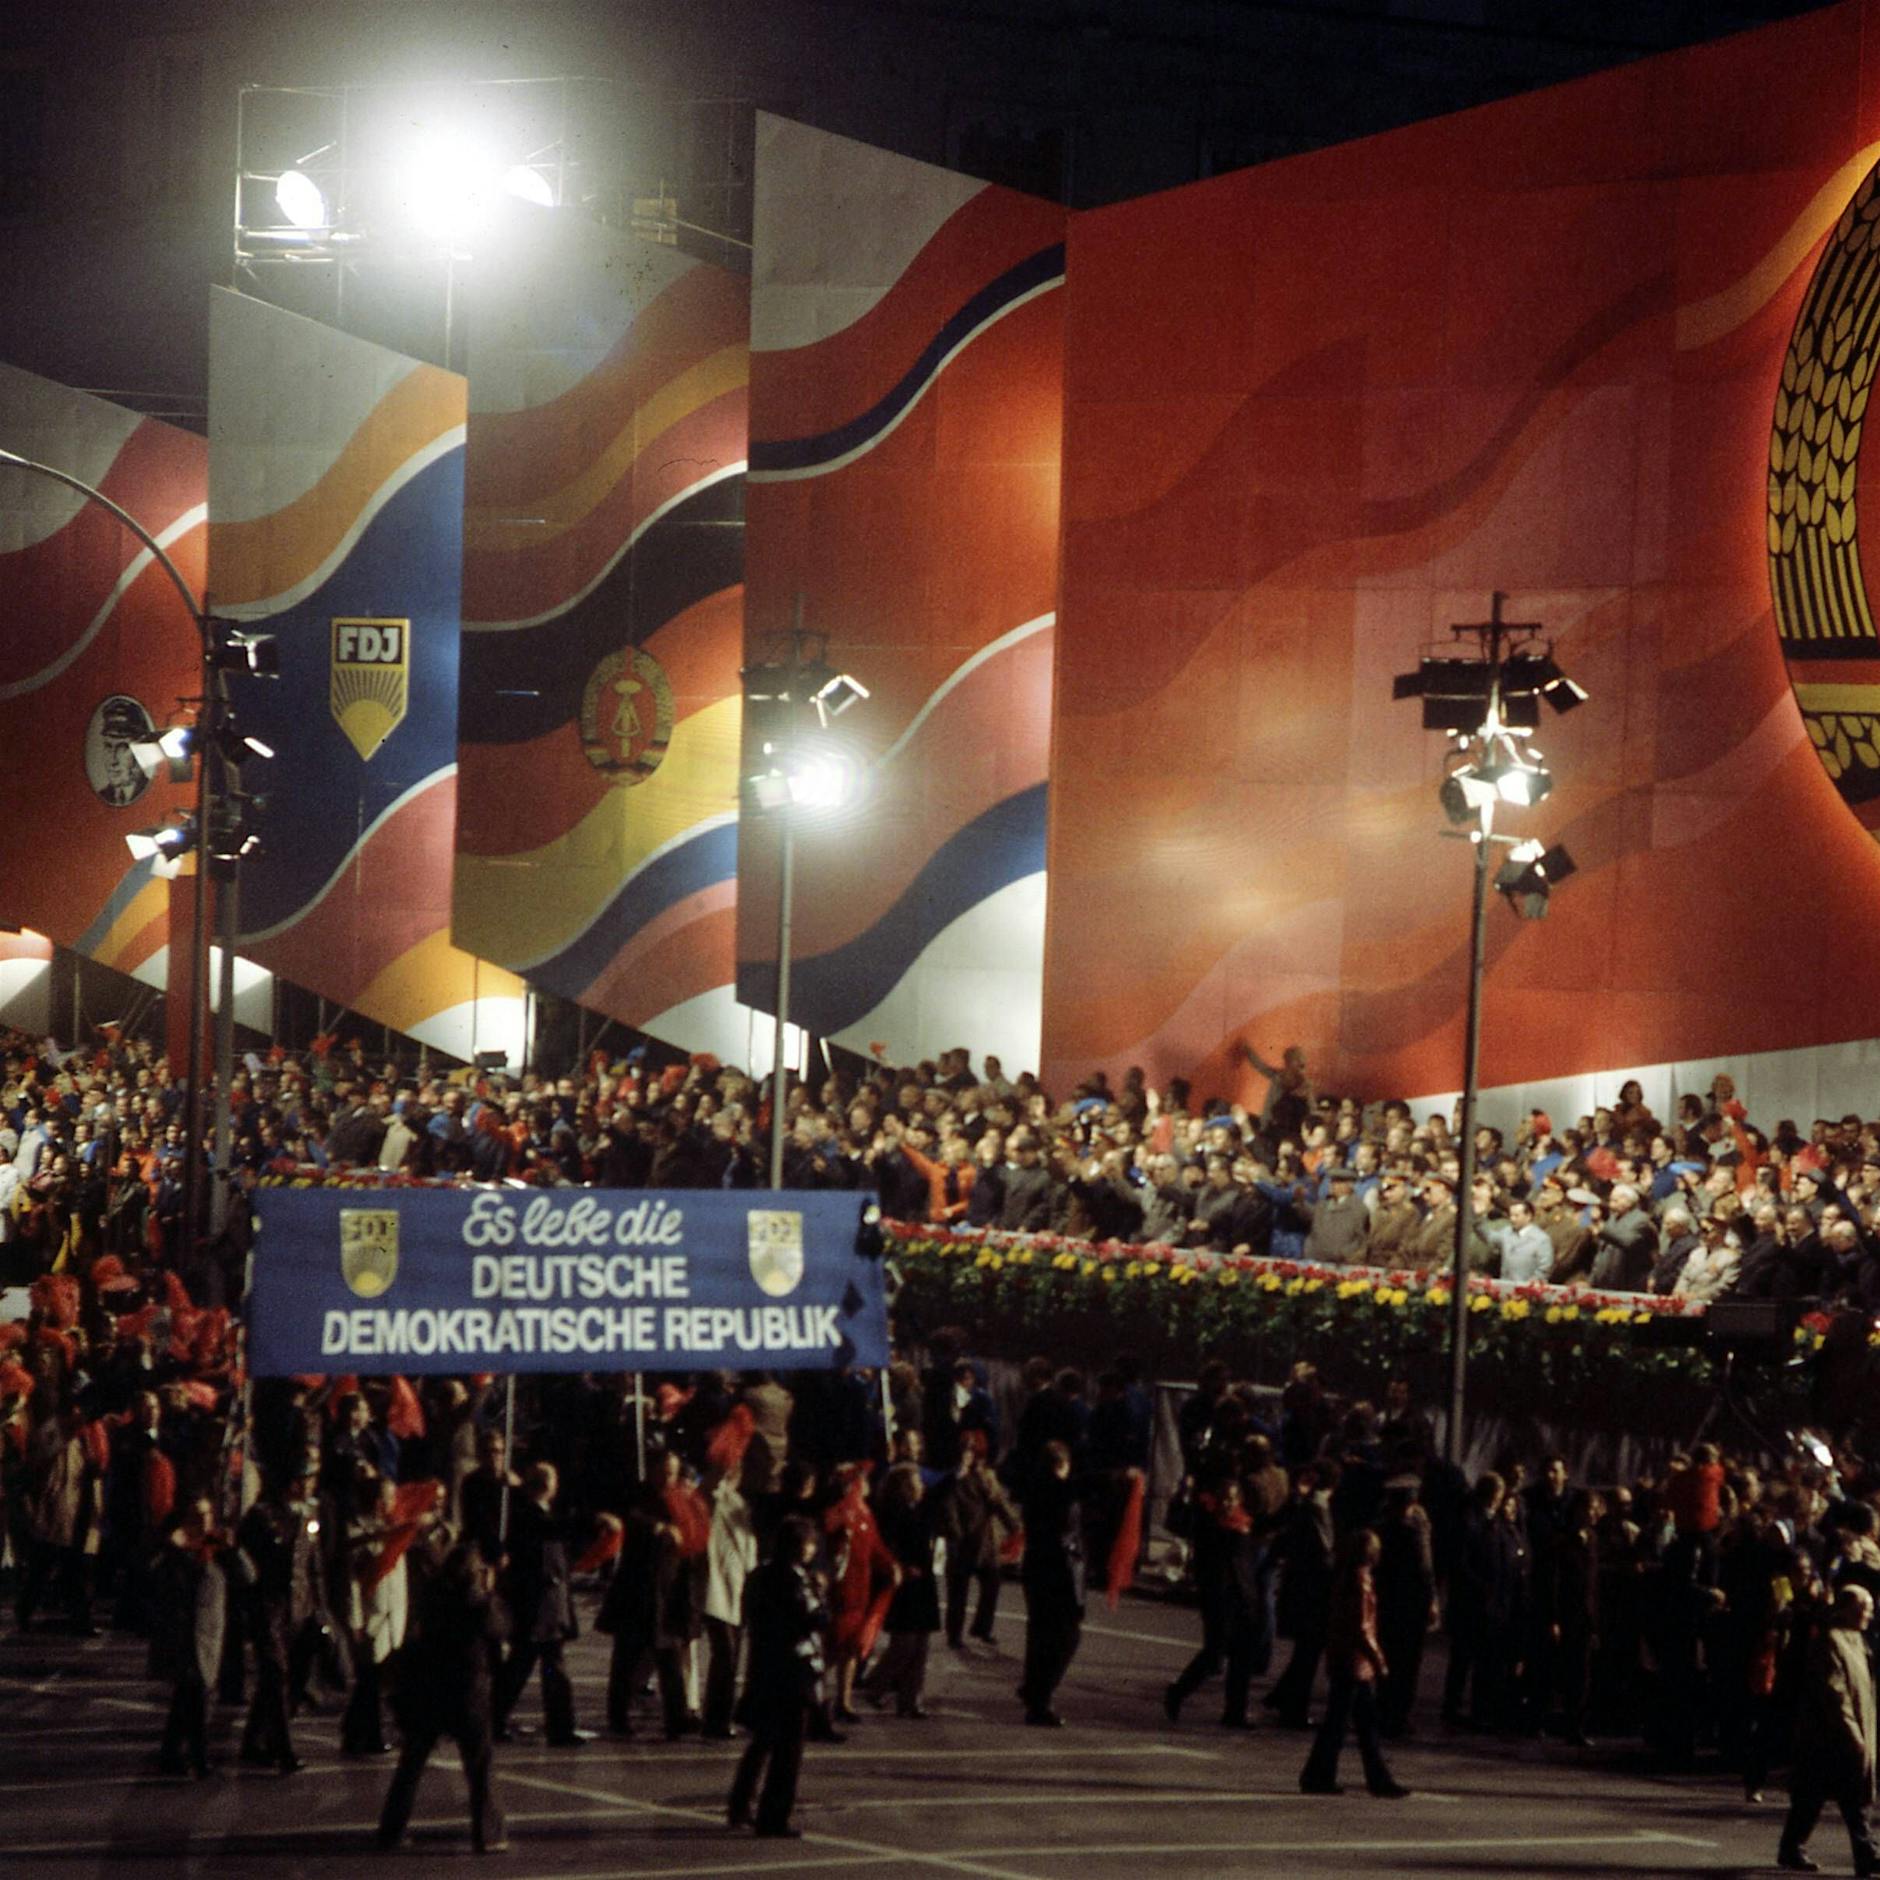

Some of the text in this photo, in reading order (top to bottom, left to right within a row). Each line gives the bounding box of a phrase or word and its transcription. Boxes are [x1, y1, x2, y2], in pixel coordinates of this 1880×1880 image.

[338, 626, 399, 662] FDJ
[462, 1192, 684, 1247] Es lebe die
[472, 1254, 690, 1299] DEUTSCHE
[321, 1305, 842, 1356] DEMOKRATISCHE REPUBLIK
